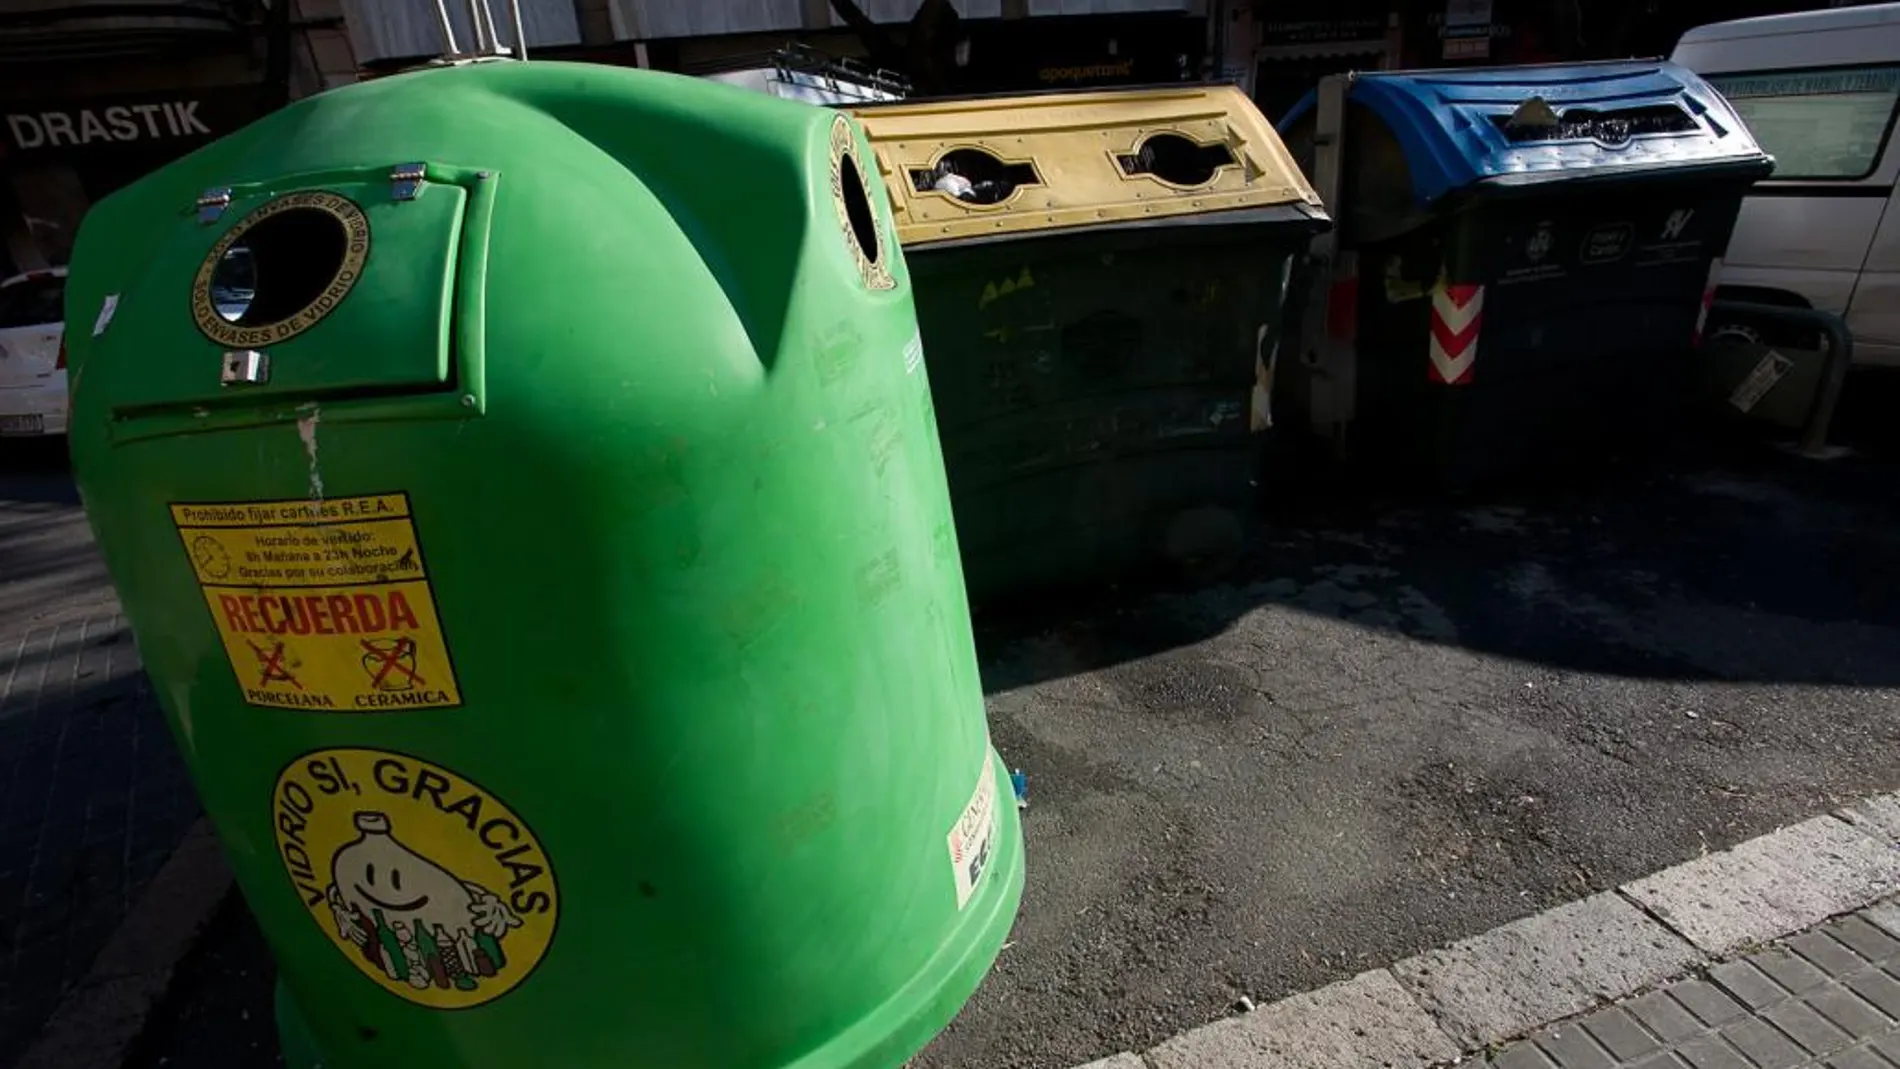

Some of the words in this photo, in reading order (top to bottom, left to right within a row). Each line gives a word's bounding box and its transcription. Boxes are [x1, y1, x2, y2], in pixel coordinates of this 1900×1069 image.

[5, 101, 212, 149] DRASTIK
[203, 317, 272, 343] ENVASES
[277, 319, 301, 337] DE
[304, 270, 354, 320] VIDRIO
[183, 506, 245, 523] Prohibido
[248, 505, 276, 524] fijar
[255, 533, 301, 547] Horario
[303, 533, 319, 546] de
[313, 552, 321, 562] a
[352, 544, 398, 558] Noche
[240, 565, 283, 578] Gracias
[285, 566, 307, 580] por
[309, 566, 325, 578] su
[219, 591, 420, 635] RECUERDA
[248, 688, 337, 708] PORCELANA
[354, 689, 451, 708] CERAMICA
[280, 780, 325, 907] VIDRIO
[307, 757, 361, 796] SI,
[373, 759, 550, 915] GRACIAS
